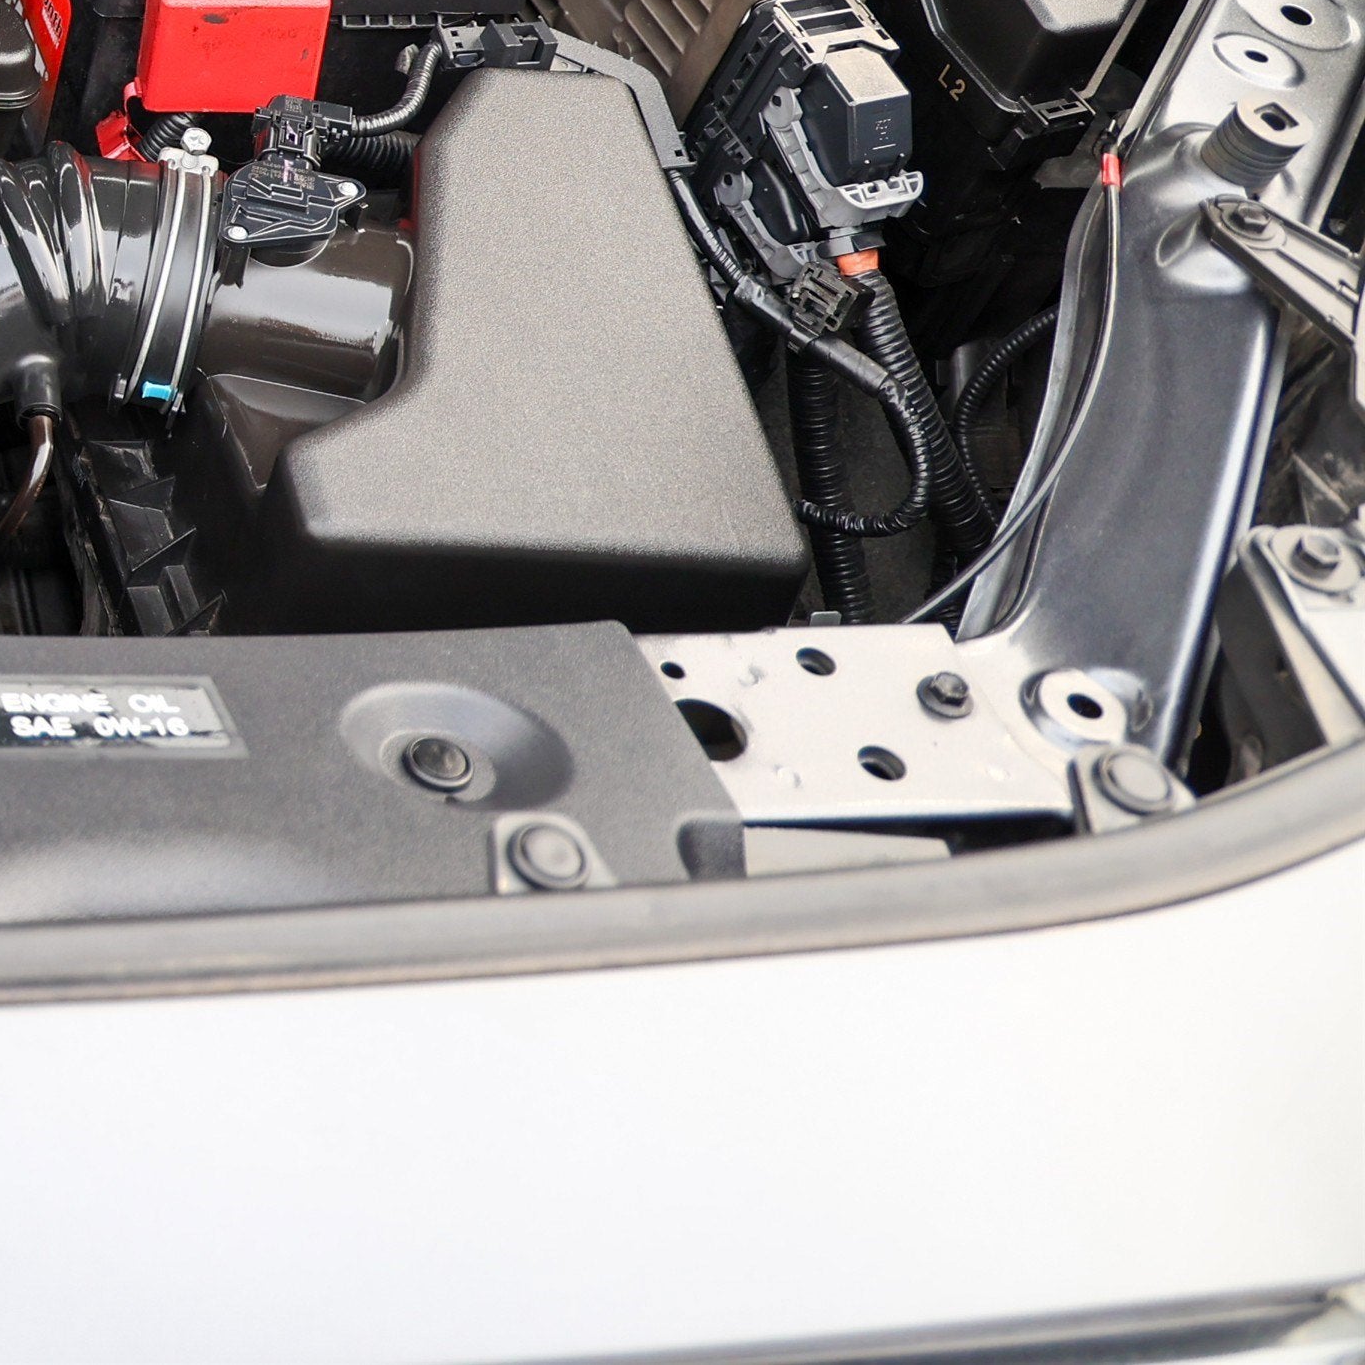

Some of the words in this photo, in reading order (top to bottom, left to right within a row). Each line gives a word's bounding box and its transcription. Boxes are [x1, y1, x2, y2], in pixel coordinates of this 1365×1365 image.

[0, 693, 113, 713] ENGINE
[127, 693, 181, 714] OIL
[10, 716, 76, 737] SAE
[93, 717, 190, 737] 0W-16
